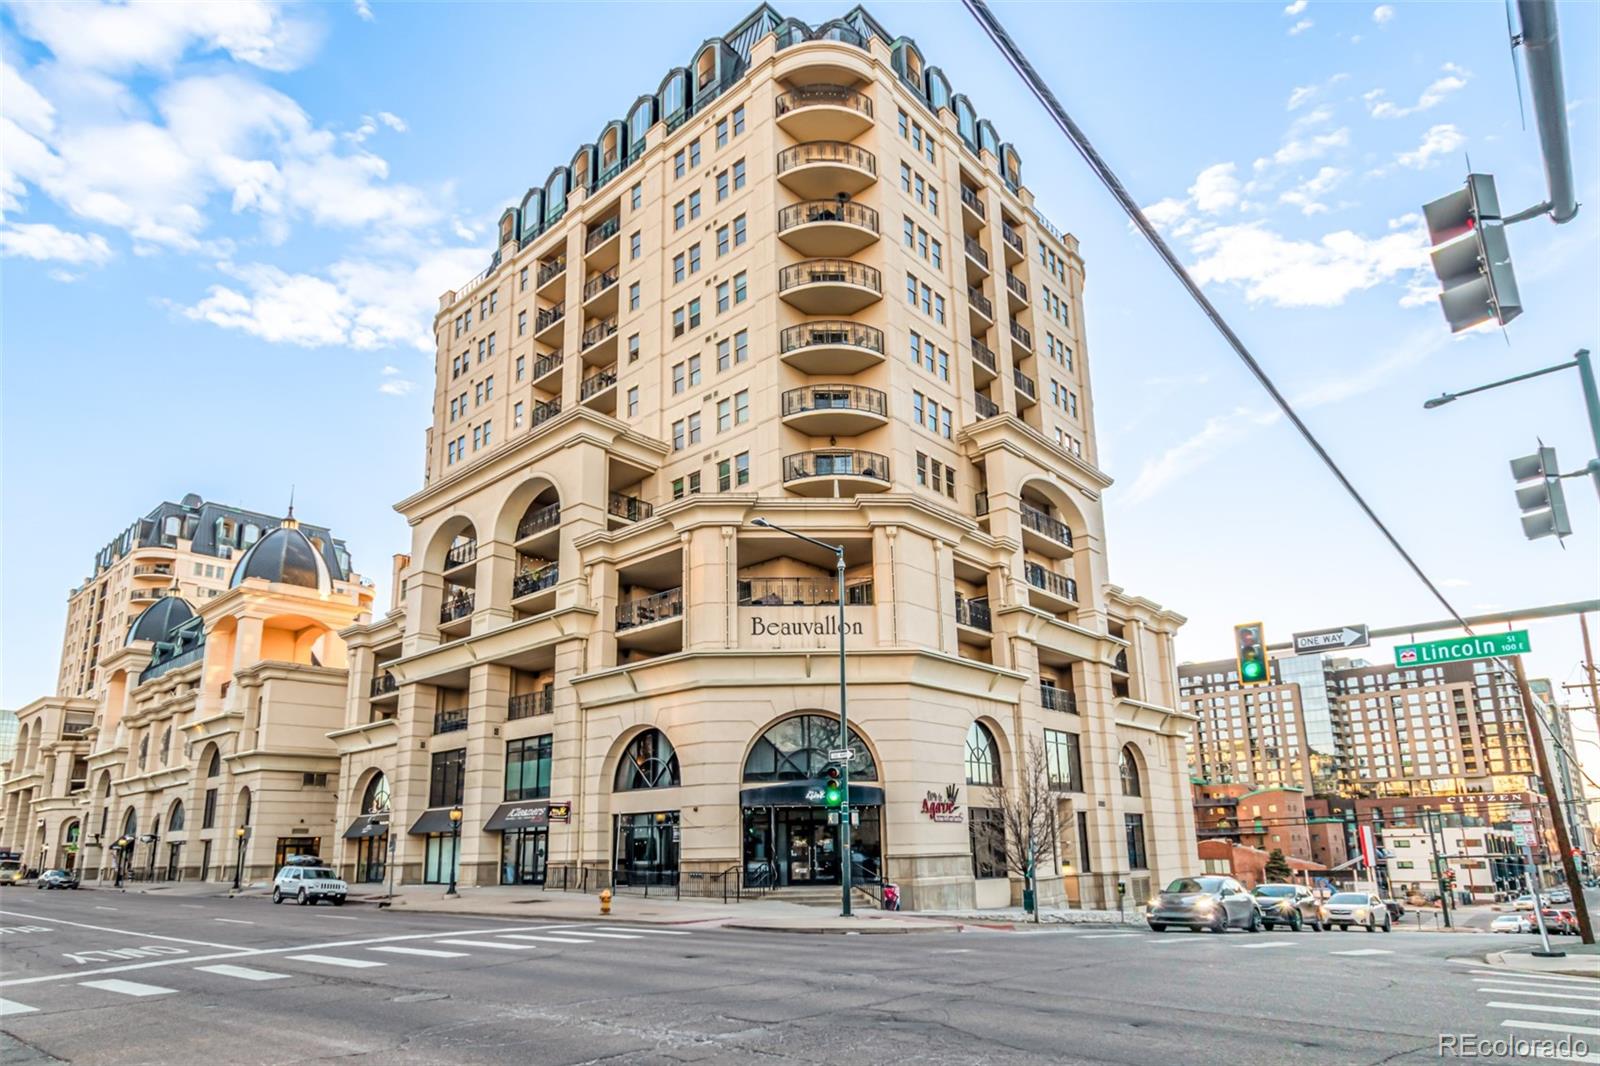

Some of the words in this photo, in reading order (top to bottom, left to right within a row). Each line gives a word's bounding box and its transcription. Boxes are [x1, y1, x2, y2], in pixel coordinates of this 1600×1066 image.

[751, 615, 864, 636] Beauvallon
[1300, 636, 1320, 647] ONE
[1323, 633, 1343, 644] WAY
[1501, 643, 1517, 652] 100
[1518, 641, 1524, 650] E
[1421, 639, 1496, 661] Lincoln
[1447, 794, 1522, 803] CITIZEN
[62, 945, 190, 964] ONLY
